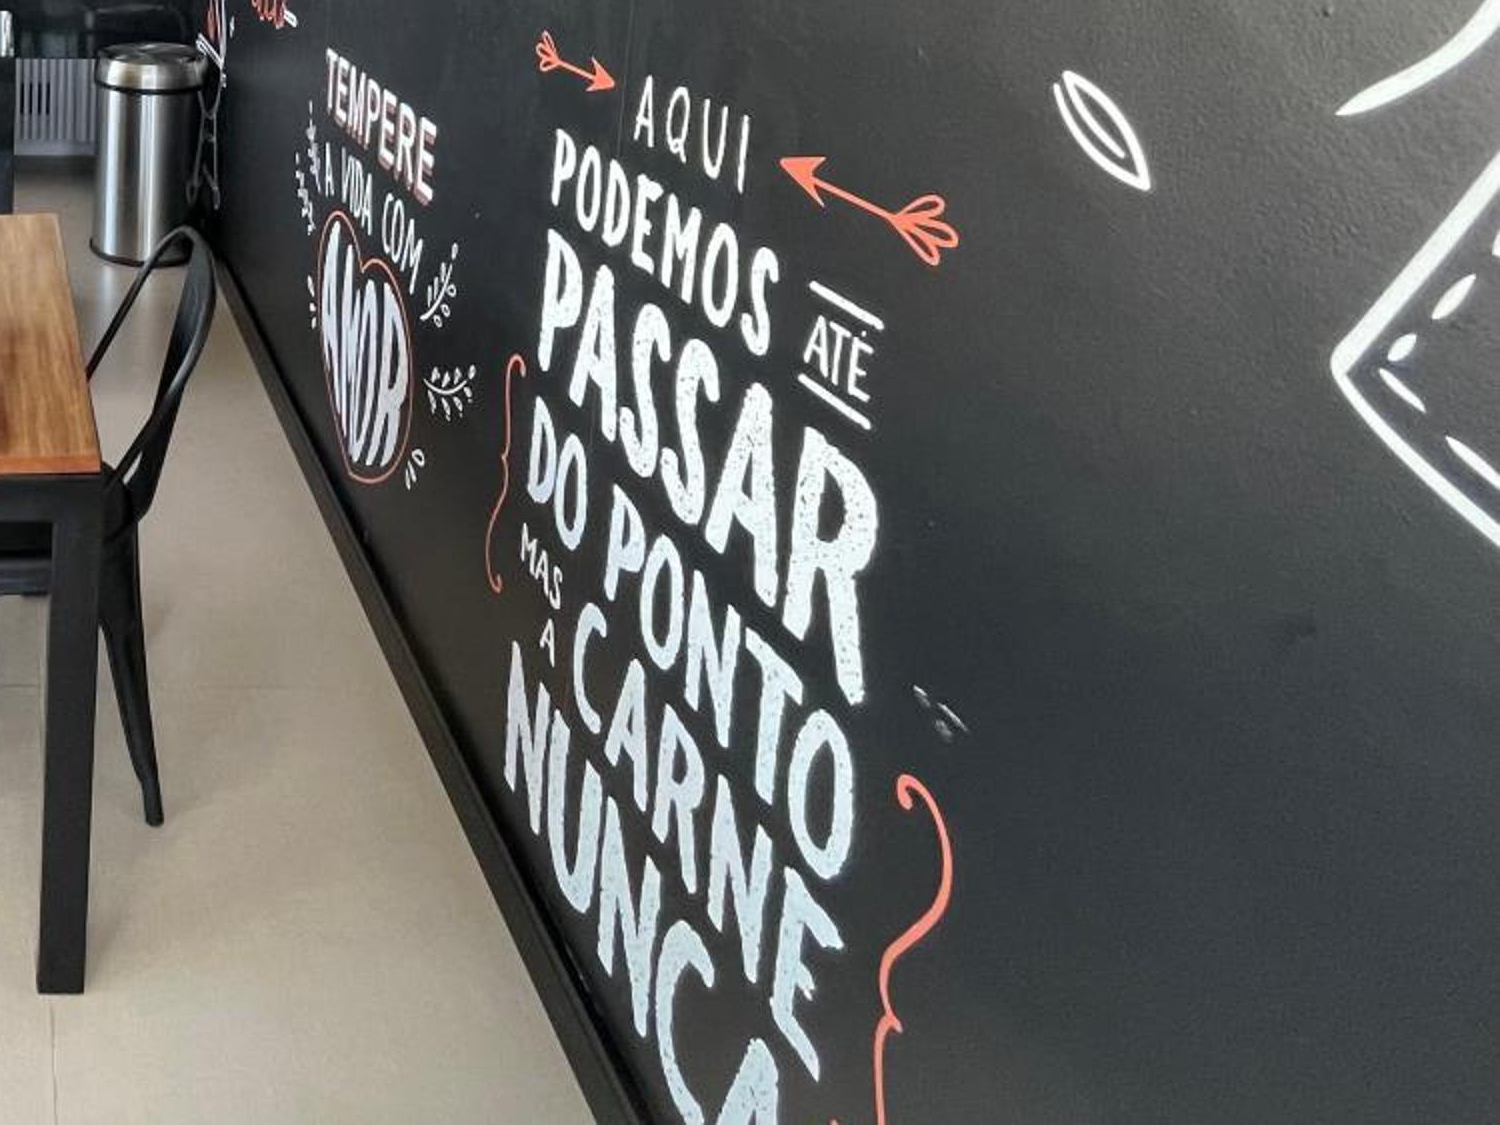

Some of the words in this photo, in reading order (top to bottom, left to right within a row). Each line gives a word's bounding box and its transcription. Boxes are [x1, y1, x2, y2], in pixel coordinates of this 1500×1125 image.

[325, 142, 335, 198] A
[341, 147, 373, 236] VIDA
[381, 192, 424, 295] COM
[326, 48, 438, 207] TEMPERE
[633, 74, 750, 194] AQUI
[550, 128, 780, 357] PODEMOS
[321, 220, 410, 467] AMOR
[803, 314, 874, 403] ATÉ
[537, 228, 879, 706] PASSAR
[520, 522, 563, 610] MAS
[527, 396, 588, 551] DO
[603, 483, 855, 881] PONTO
[539, 618, 556, 668] A
[573, 602, 845, 1083] CARNE
